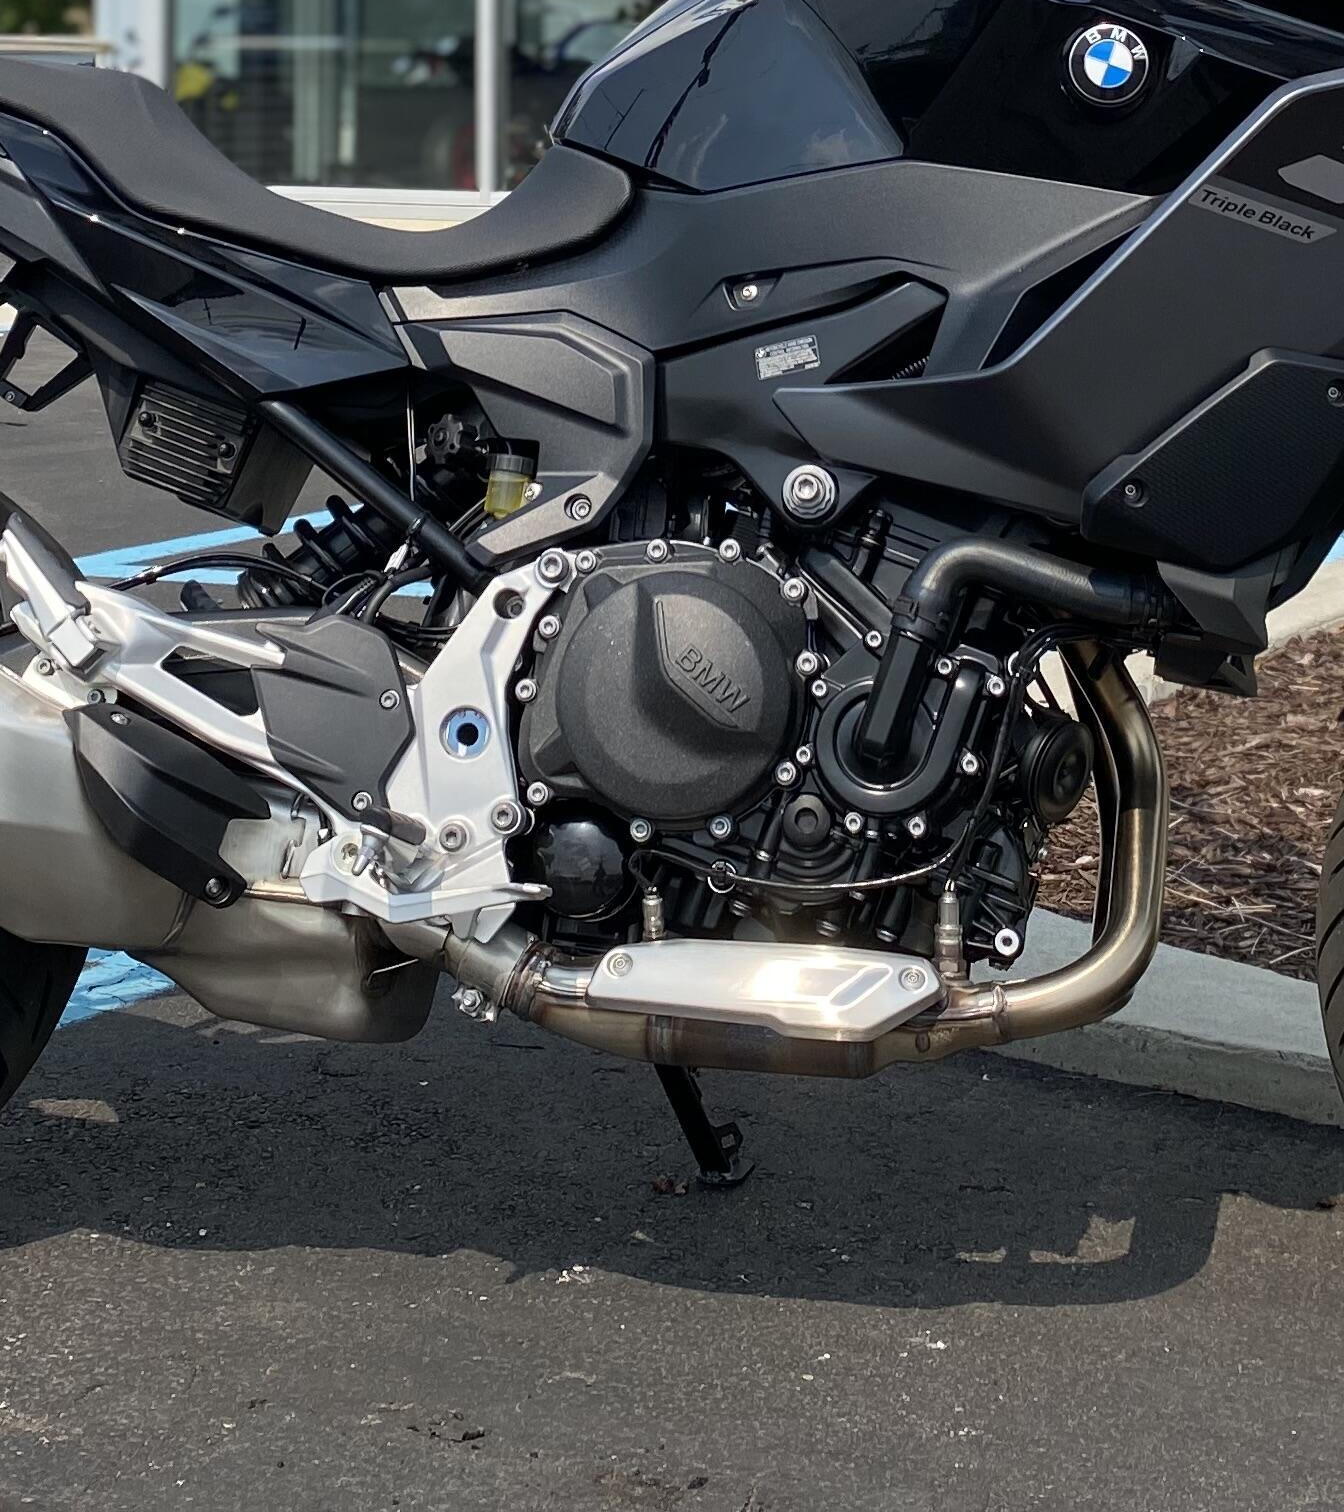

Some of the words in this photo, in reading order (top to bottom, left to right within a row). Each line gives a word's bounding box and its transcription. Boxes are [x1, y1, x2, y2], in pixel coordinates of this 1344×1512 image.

[1084, 27, 1147, 61] BMW
[1199, 188, 1256, 219] Triple
[1258, 209, 1316, 240] Black
[674, 643, 752, 714] BMW
